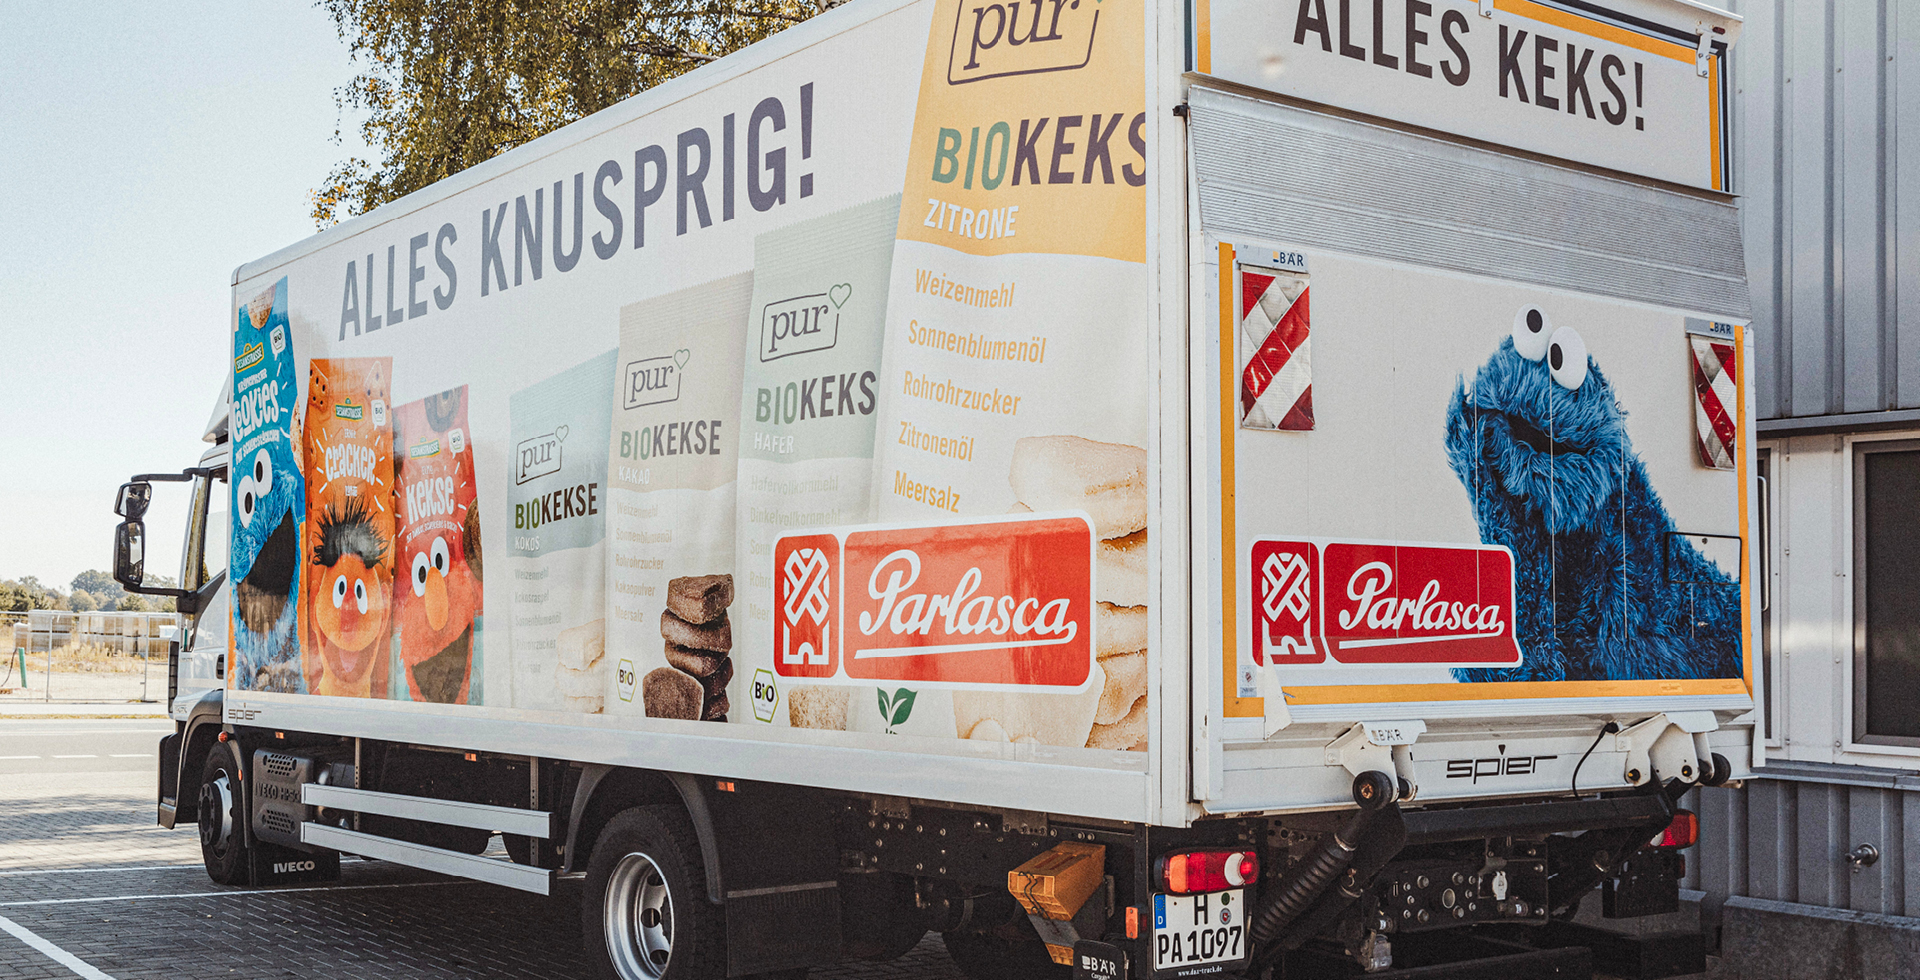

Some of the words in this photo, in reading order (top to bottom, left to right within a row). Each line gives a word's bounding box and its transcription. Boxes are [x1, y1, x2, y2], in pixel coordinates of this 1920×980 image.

[963, 0, 1080, 70] pur
[1293, 0, 1470, 87] ALLES
[1499, 25, 1644, 132] KEKS!
[339, 222, 457, 341] ALLES
[481, 81, 814, 297] KNUSPRIG!
[924, 198, 1019, 239] ZITRONE
[1280, 251, 1304, 266] BÄR
[915, 269, 1015, 308] Weizenmehl
[768, 304, 829, 353] pur
[908, 319, 1047, 363] Sonnenblumenöl
[1714, 322, 1731, 334] BÄR
[630, 365, 674, 403] pur
[903, 370, 1021, 415] Rohrohrzucker
[521, 440, 556, 478] pur
[620, 420, 722, 460] BIOKEKSE
[754, 432, 794, 454] HAFER
[898, 420, 974, 462] Zitronenöl
[618, 466, 650, 484] KAKAO
[751, 475, 839, 495] Hafervollkornmehl
[894, 470, 960, 513] Meersalz
[515, 482, 598, 530] BIOKEKSE
[617, 501, 658, 519] Weizenmehl
[750, 507, 840, 526] Dinkelvollkornmehl
[515, 536, 540, 551] KOKOS
[616, 528, 672, 544] Sonnenblumenöl
[615, 553, 664, 570] Rohrohrzucker
[615, 579, 655, 597] Kakaopulver
[859, 549, 1078, 642] Parlasca
[1338, 561, 1505, 634] Parlasca
[614, 606, 644, 623] Meersalz
[1378, 729, 1403, 741] BÄR
[1447, 744, 1557, 784] spier
[274, 861, 315, 873] IVECO
[1194, 894, 1208, 925] H
[1091, 957, 1116, 976] BÄR
